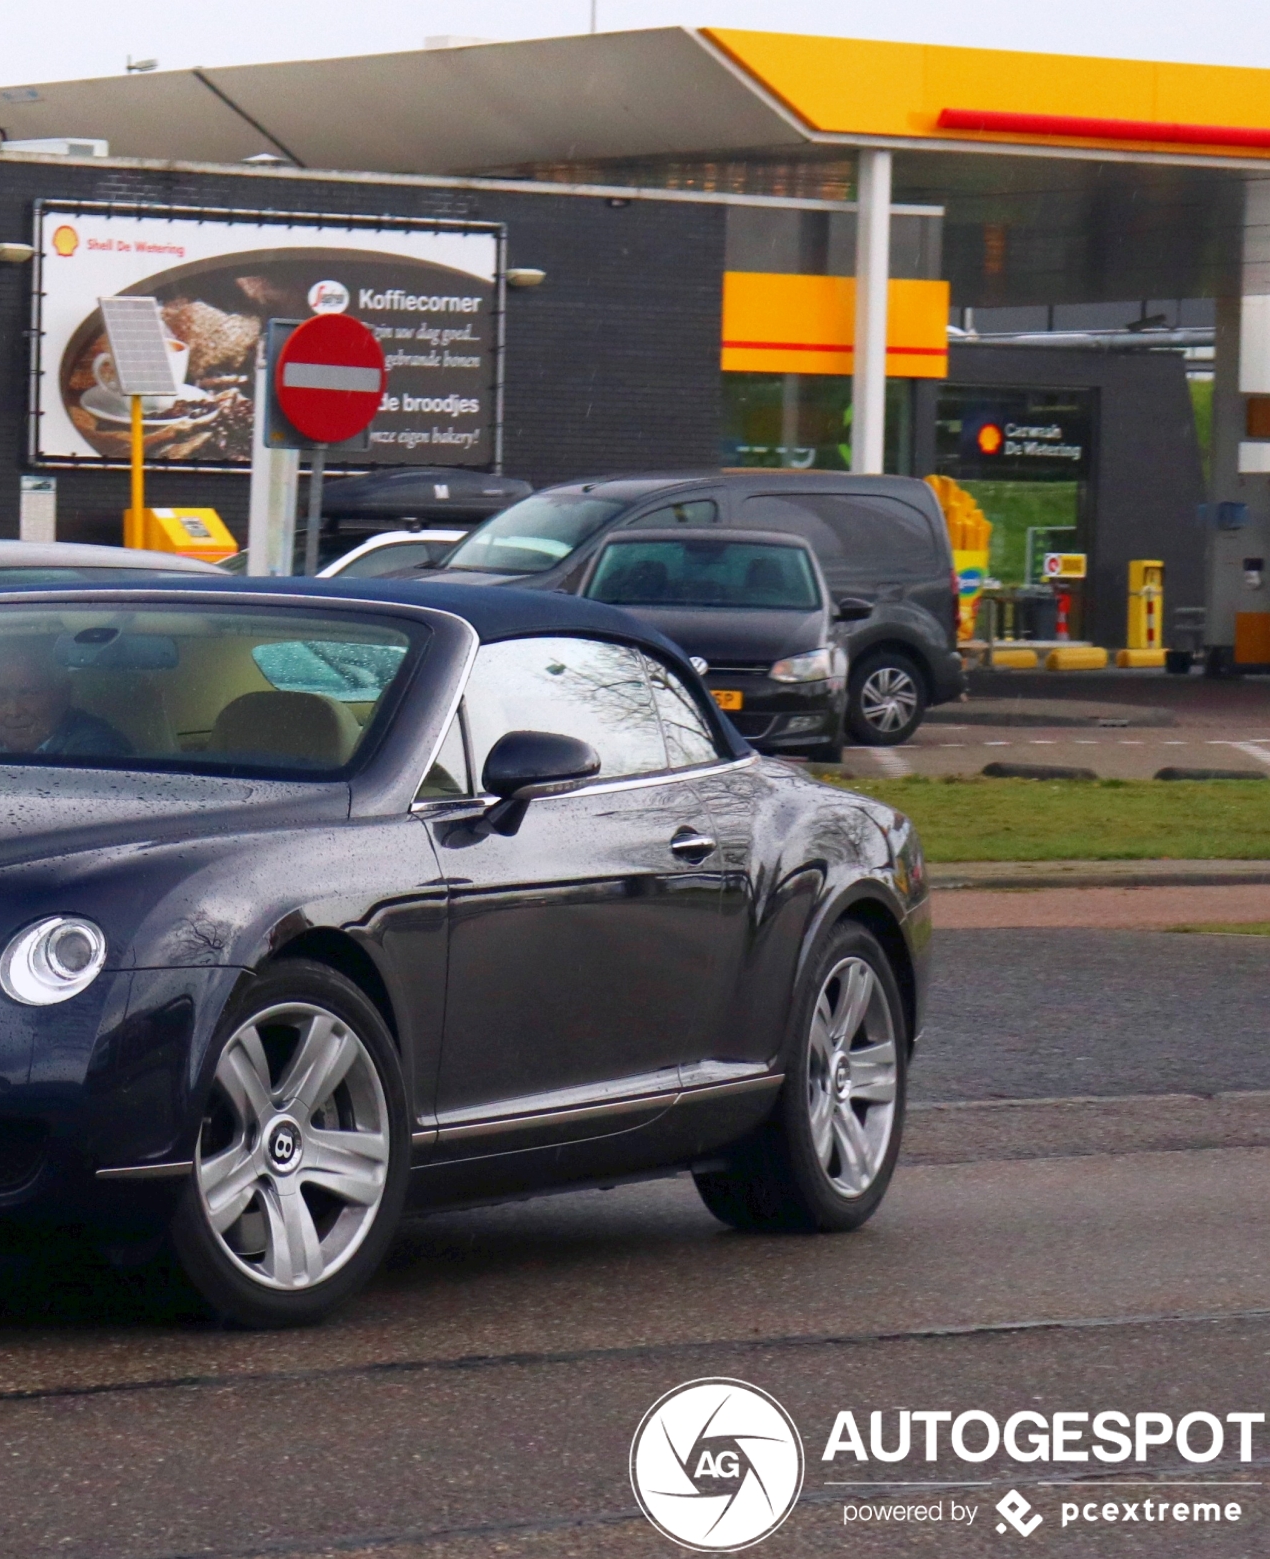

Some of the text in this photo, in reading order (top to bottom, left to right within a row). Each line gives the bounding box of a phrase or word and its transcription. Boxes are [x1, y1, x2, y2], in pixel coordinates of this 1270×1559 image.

[87, 239, 185, 258] Shell De Wetering
[358, 288, 483, 312] Koffiecorner
[416, 322, 441, 346] dag
[402, 393, 480, 417] broodjes
[397, 428, 430, 449] eigen
[431, 426, 481, 449] bakery!
[1005, 422, 1063, 439] Carwash
[1004, 441, 1082, 460] De Wetering
